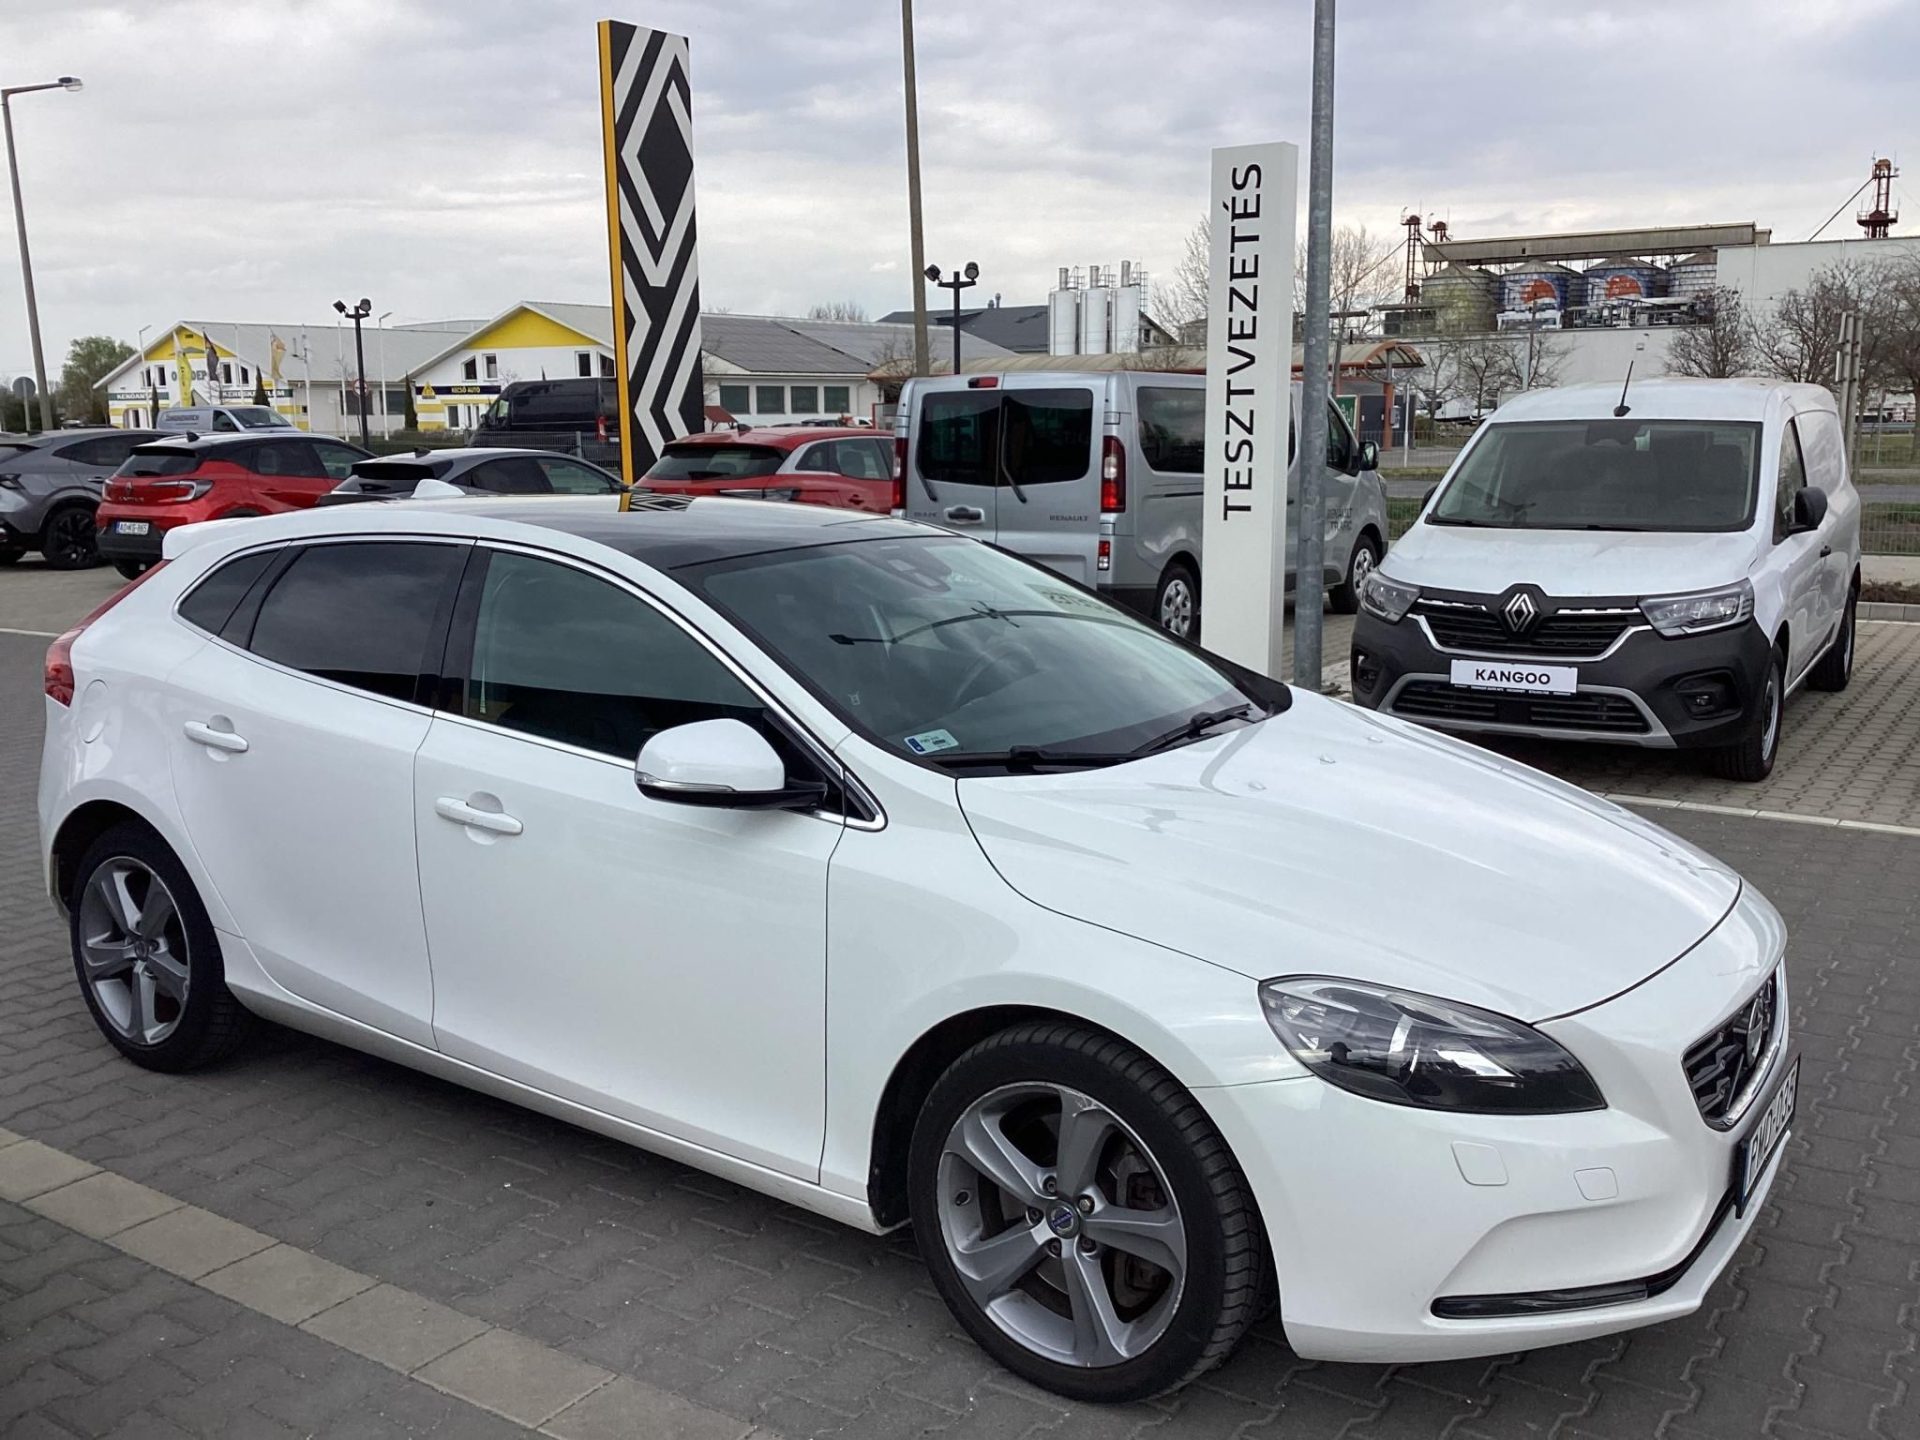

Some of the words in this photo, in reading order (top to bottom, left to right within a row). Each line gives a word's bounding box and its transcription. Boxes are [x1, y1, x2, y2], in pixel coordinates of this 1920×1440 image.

[1222, 162, 1263, 521] TESZTVEZETÉS
[1049, 514, 1089, 522] RENAULT
[1475, 668, 1551, 685] KANGOO
